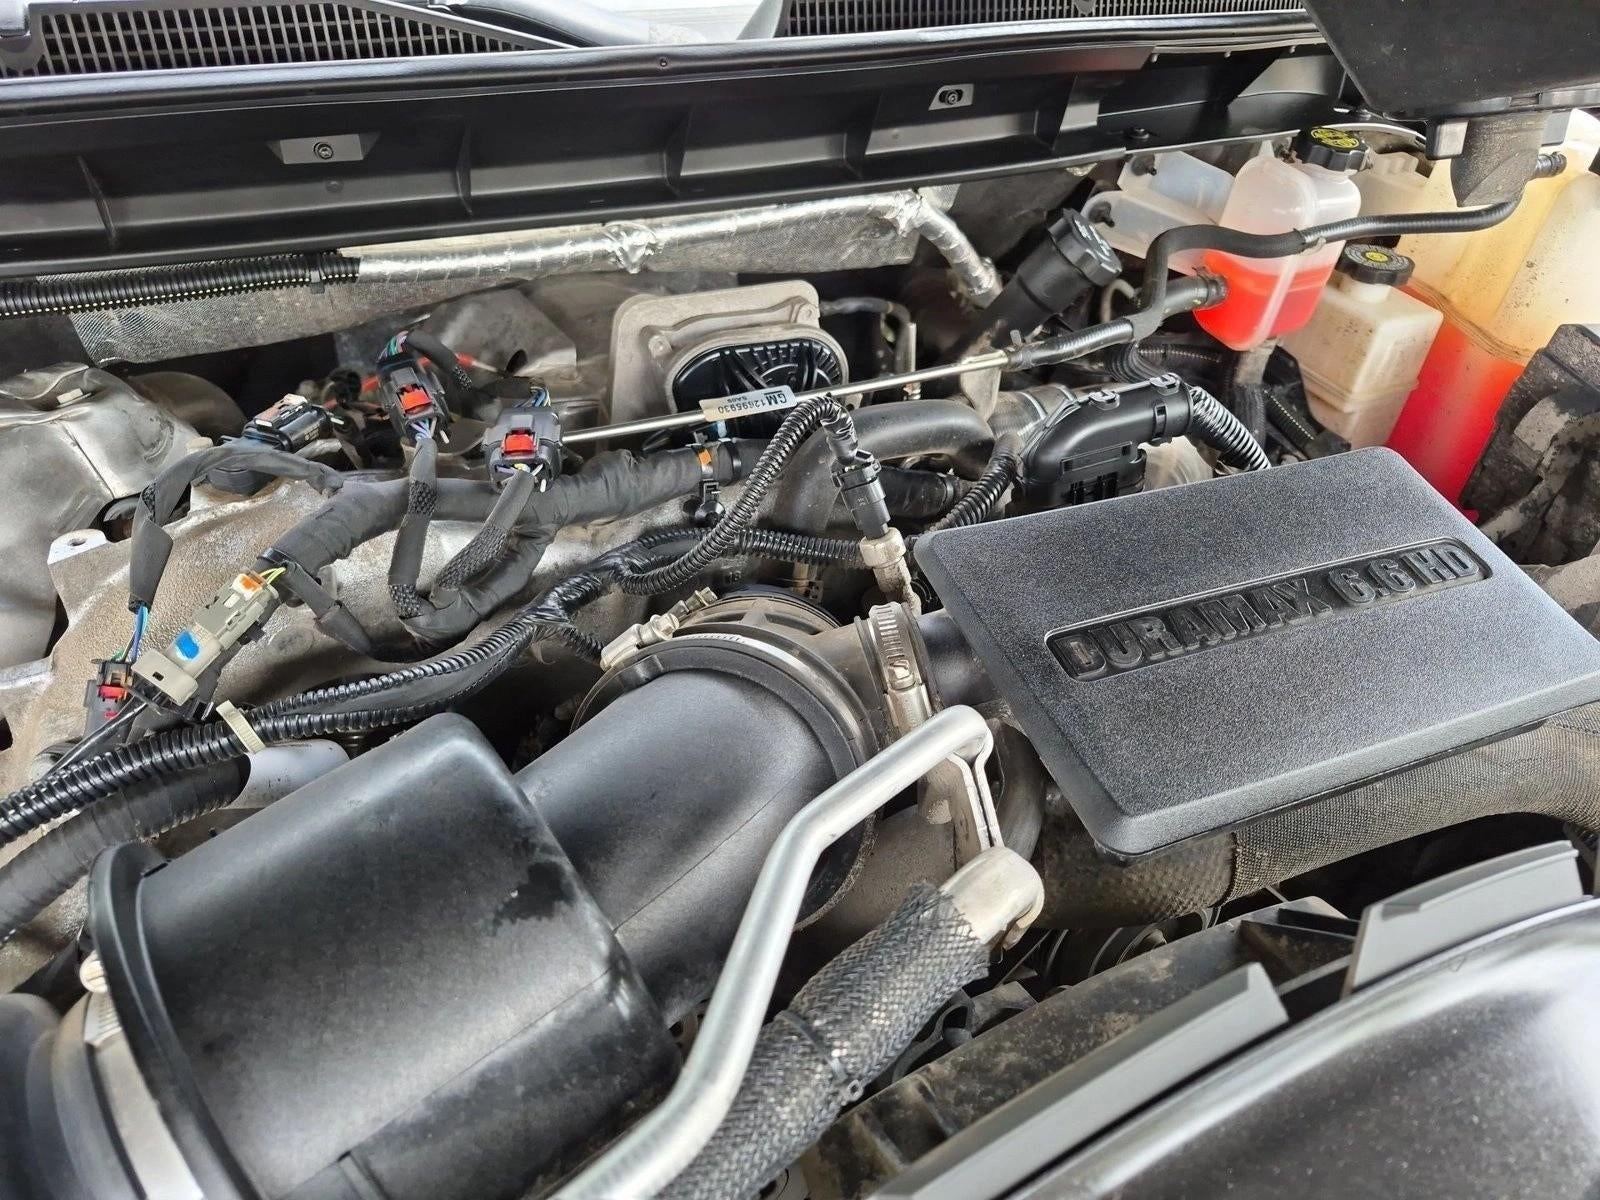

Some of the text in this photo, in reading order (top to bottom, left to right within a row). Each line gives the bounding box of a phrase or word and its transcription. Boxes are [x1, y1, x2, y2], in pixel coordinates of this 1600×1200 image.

[764, 391, 787, 406] GM
[1054, 545, 1480, 677] DURAMAX 6.6 HD
